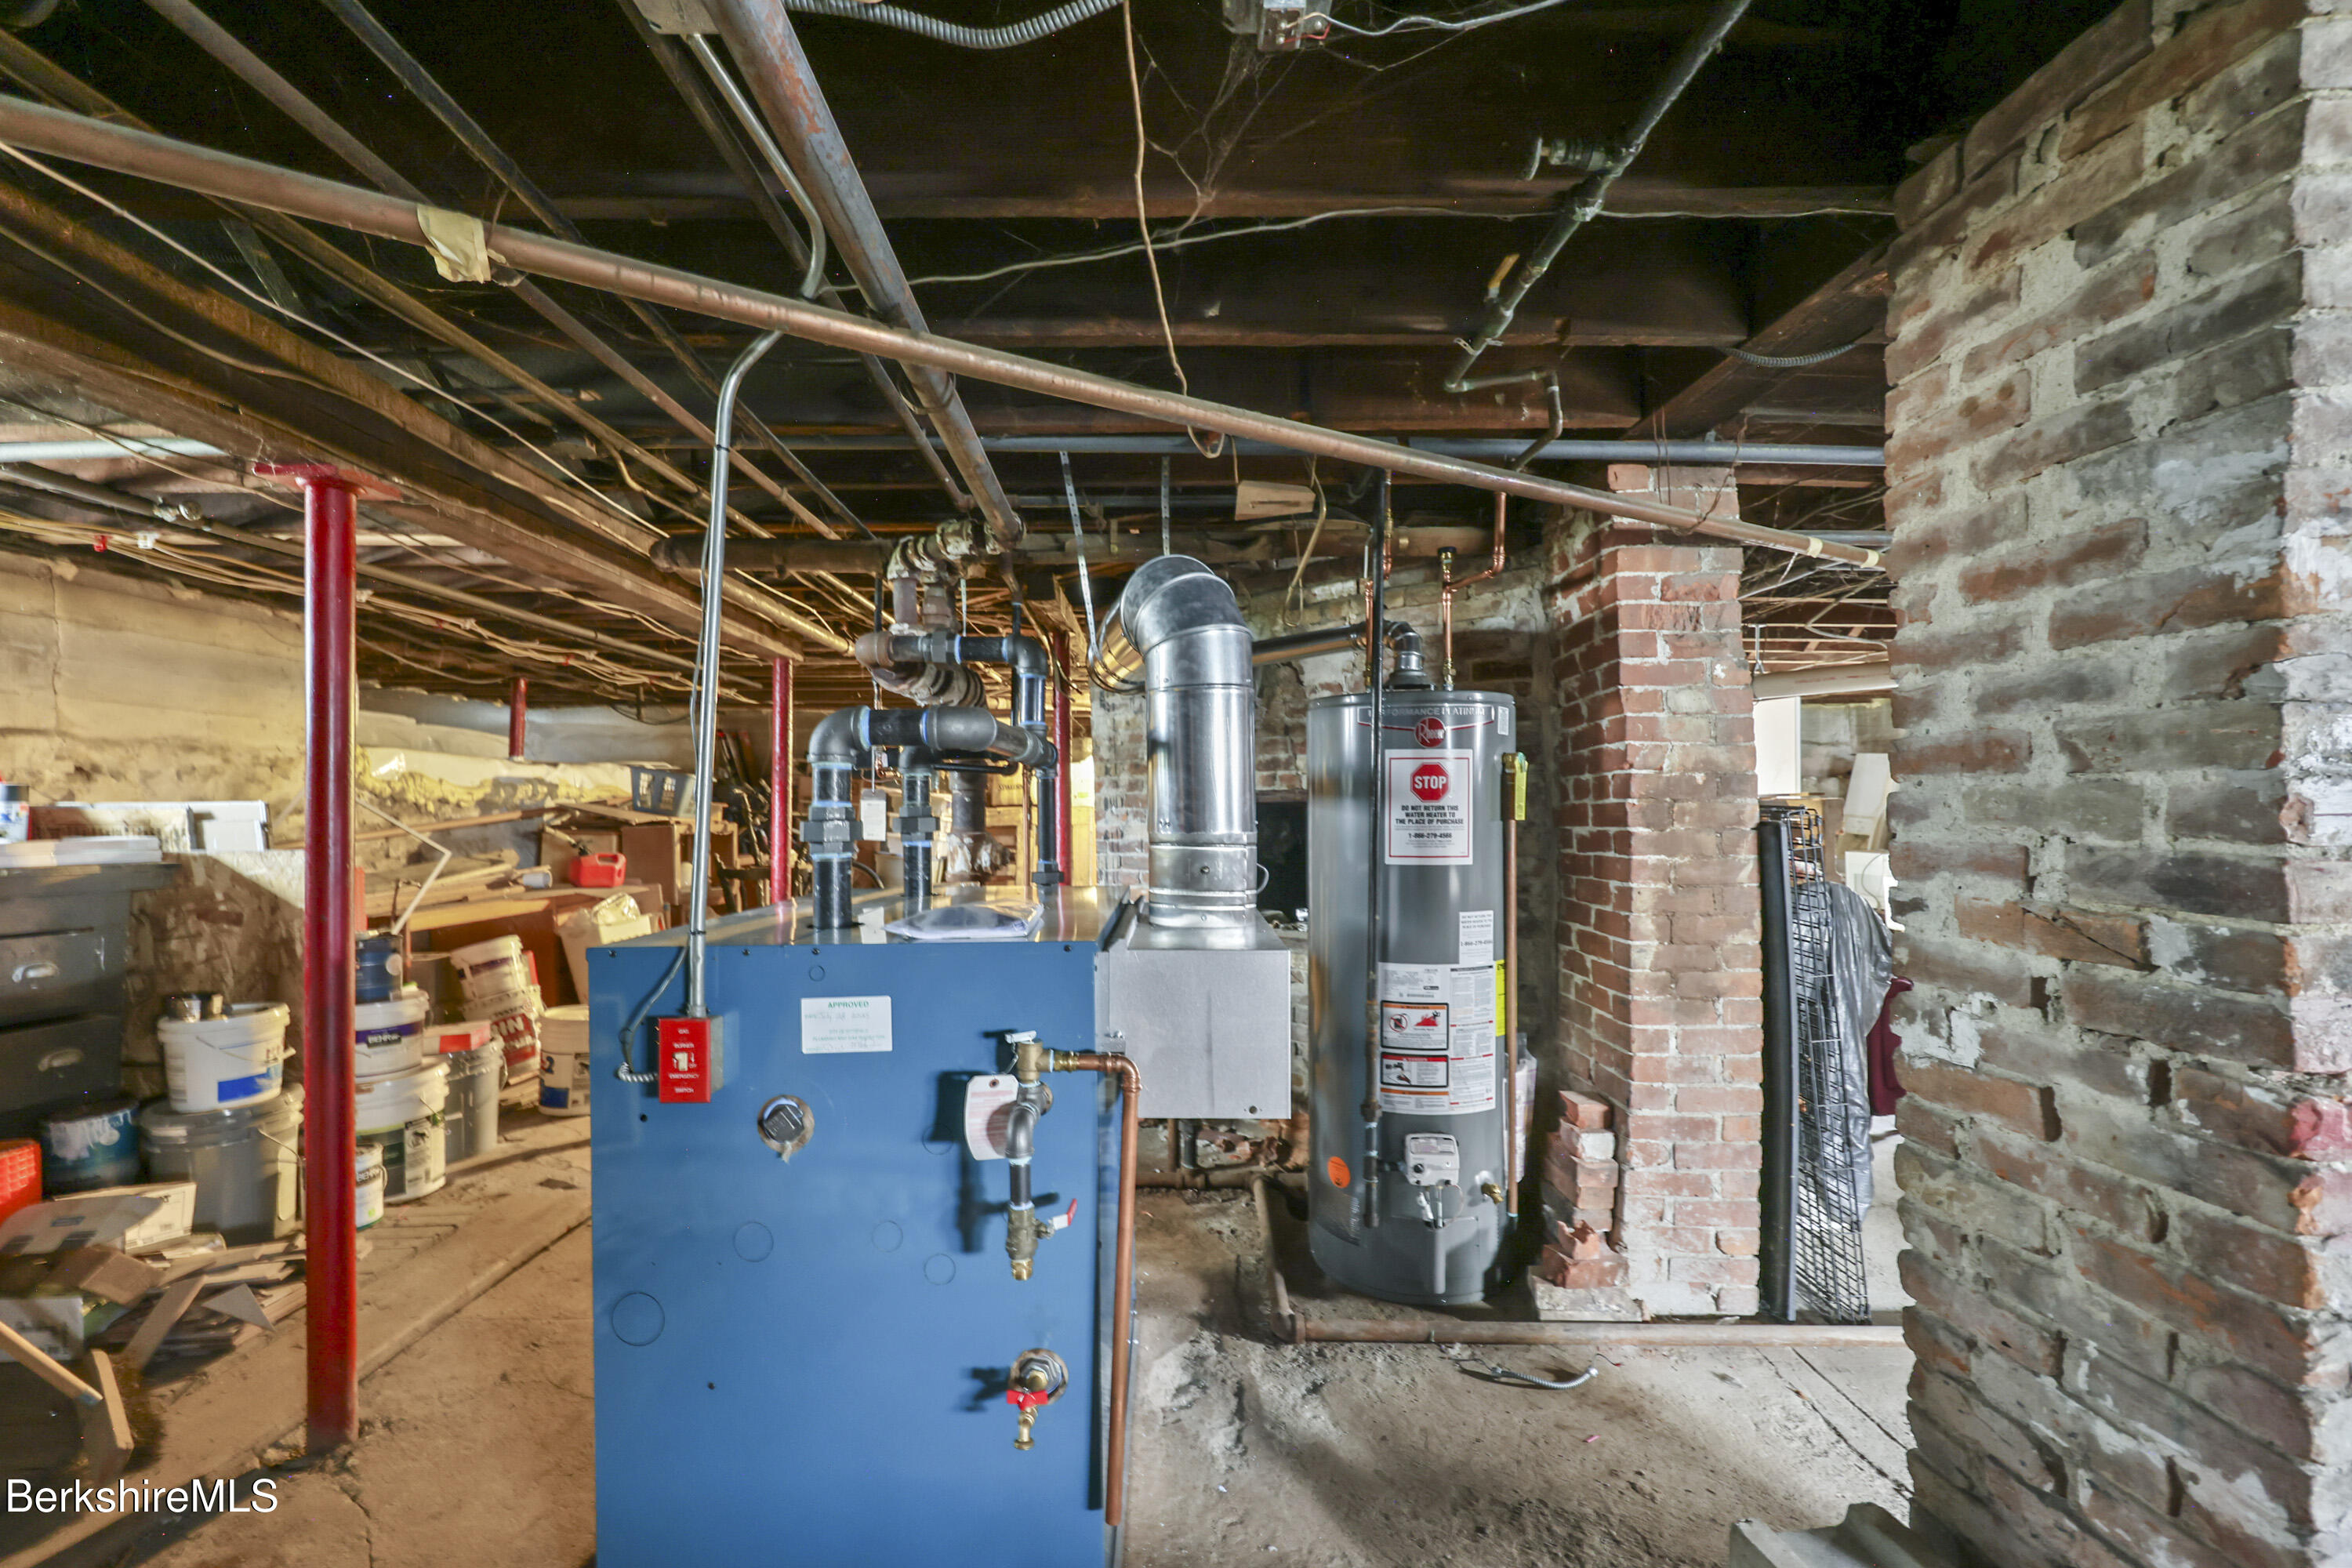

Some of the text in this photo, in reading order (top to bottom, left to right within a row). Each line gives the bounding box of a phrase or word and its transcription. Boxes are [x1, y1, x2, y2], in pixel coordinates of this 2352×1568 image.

[1442, 706, 1485, 716] PLATINUM
[1417, 718, 1445, 743] Rheem
[1414, 775, 1447, 789] STOP
